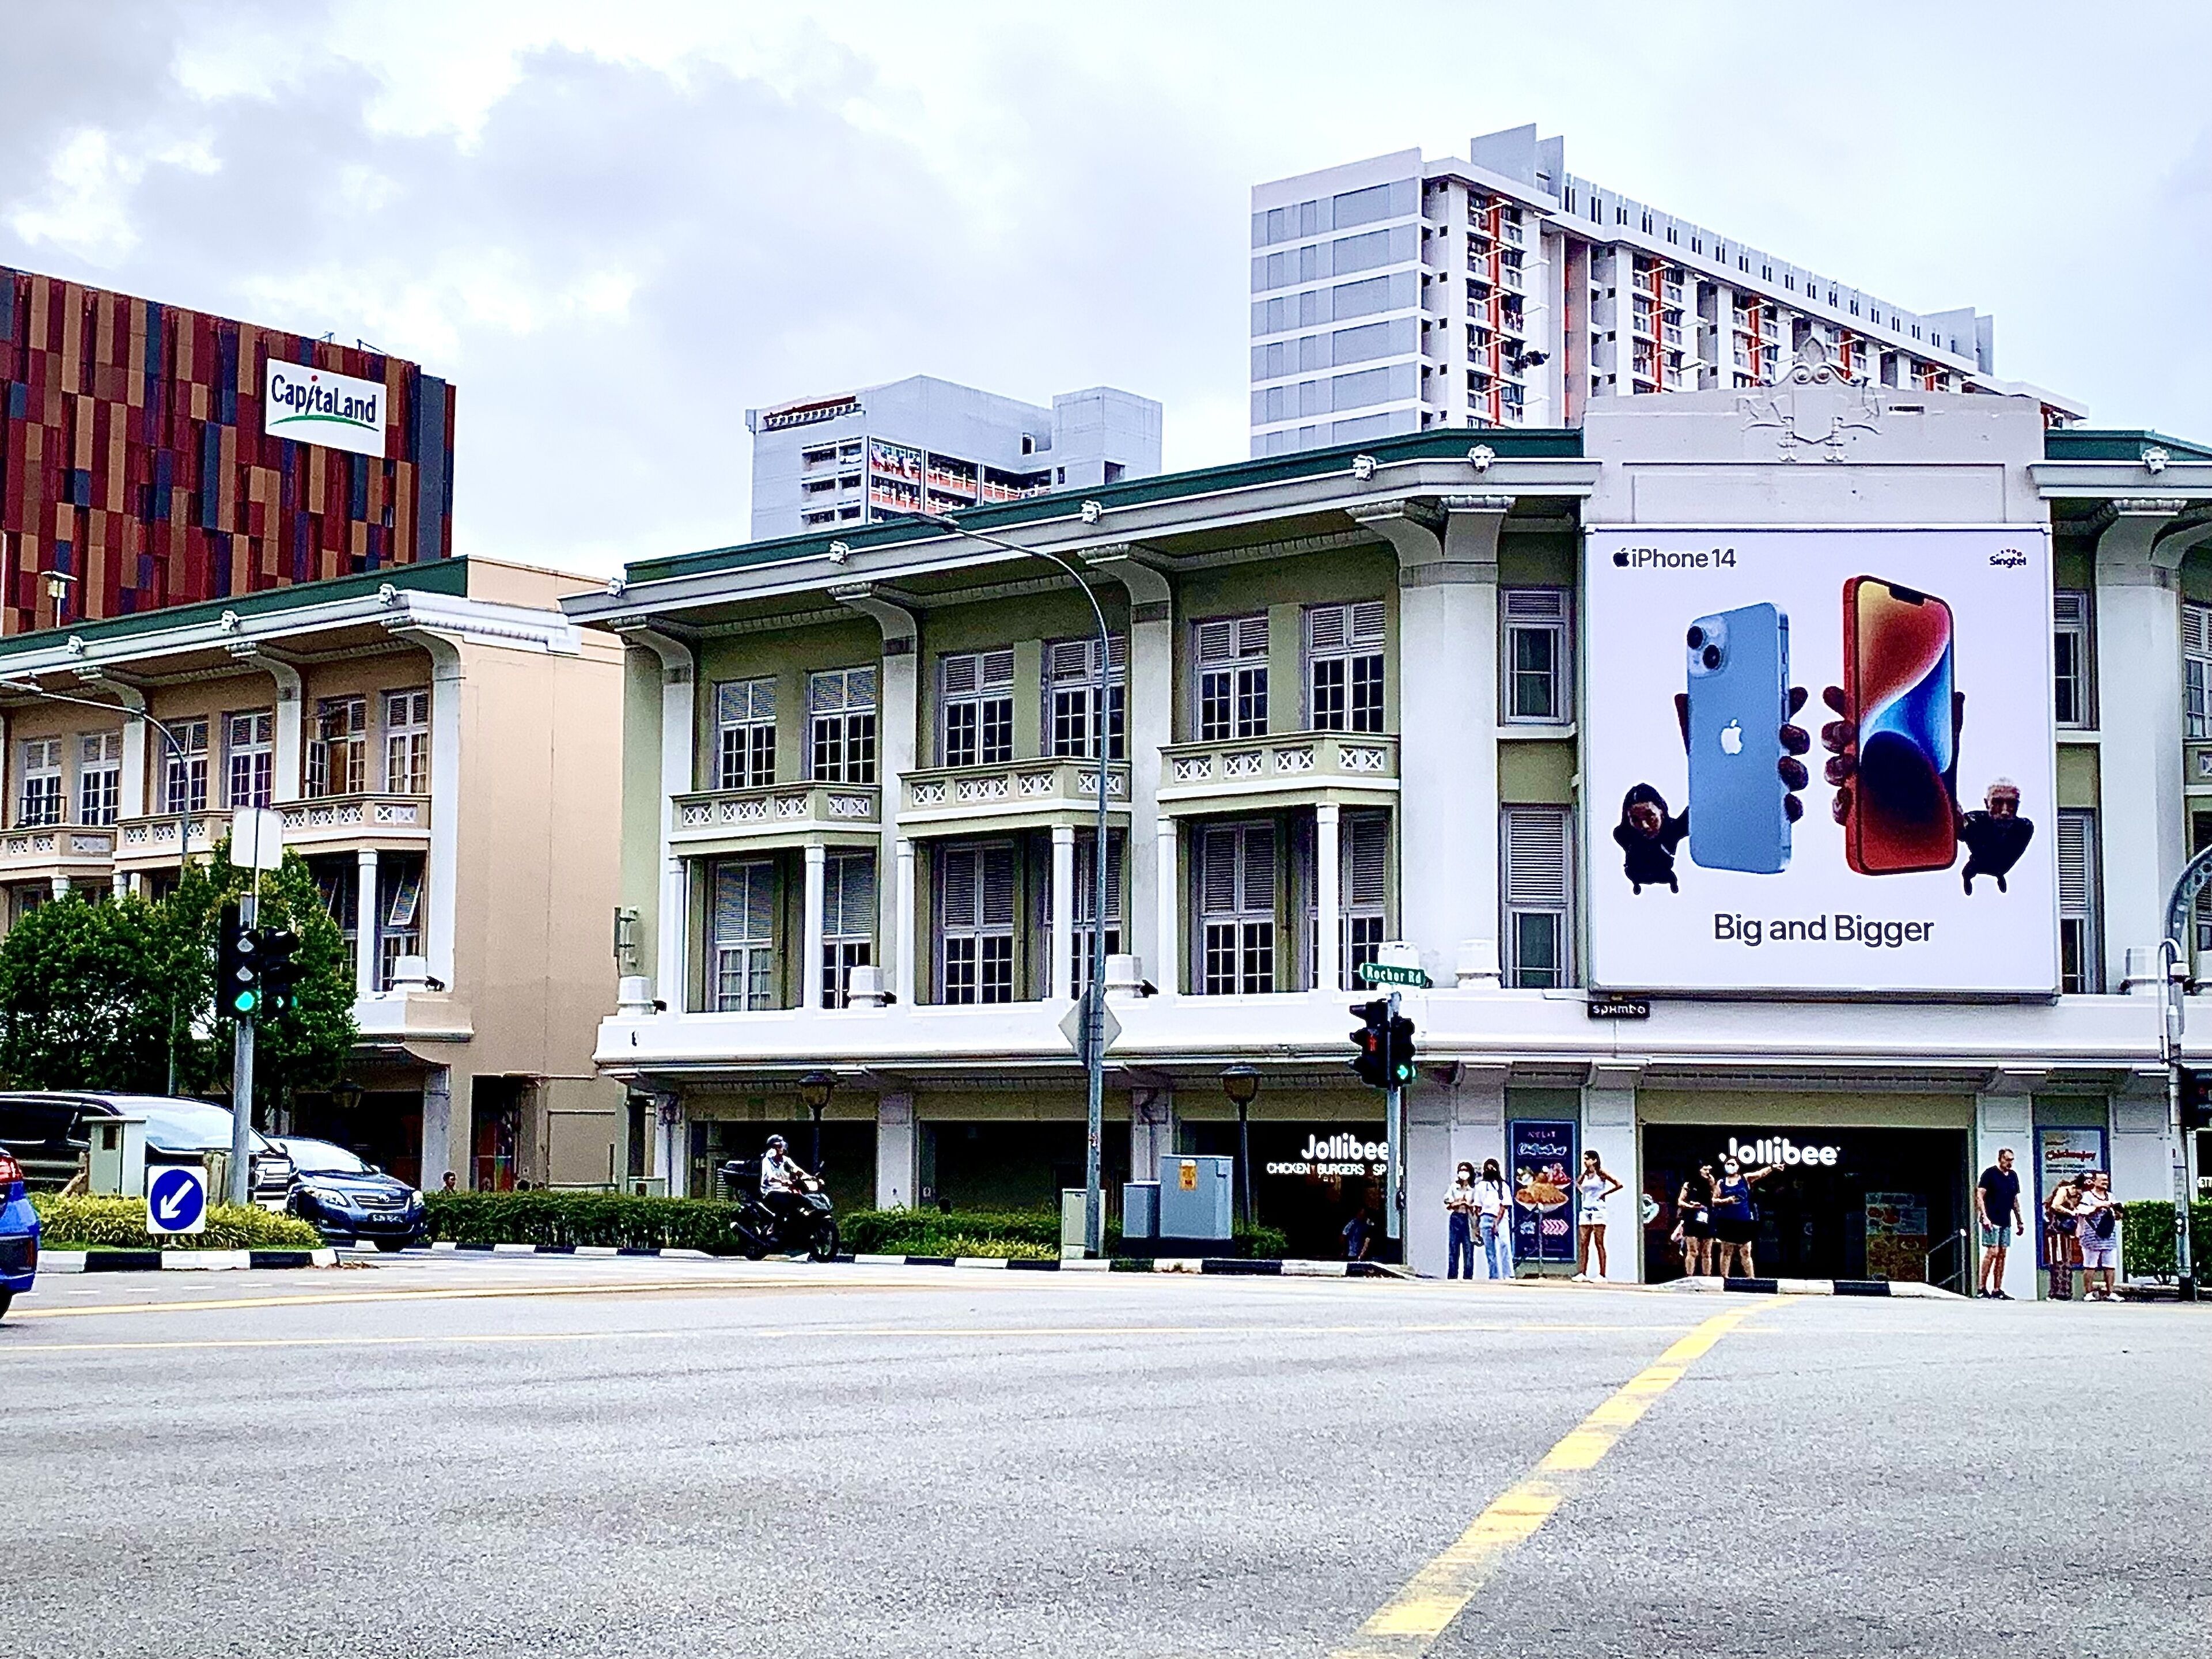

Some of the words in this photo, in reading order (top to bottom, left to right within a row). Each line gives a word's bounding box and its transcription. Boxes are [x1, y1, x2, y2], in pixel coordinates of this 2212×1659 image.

[272, 374, 376, 423] CapitaLand
[1632, 548, 1709, 567] iPhone
[1711, 548, 1736, 567] 14
[1990, 555, 2027, 569] Singtel
[1714, 914, 1762, 946] Big
[1770, 914, 1827, 940] and
[1835, 915, 1934, 948] Bigger
[1366, 965, 1404, 982] Rochor
[1408, 970, 1421, 984] Rd
[1301, 1132, 1389, 1160] Jollibee
[1718, 1136, 1838, 1166] Jollibee
[1267, 1162, 1311, 1175] CHICKEN
[1317, 1163, 1365, 1176] BURGERS
[1372, 1164, 1387, 1176] SP
